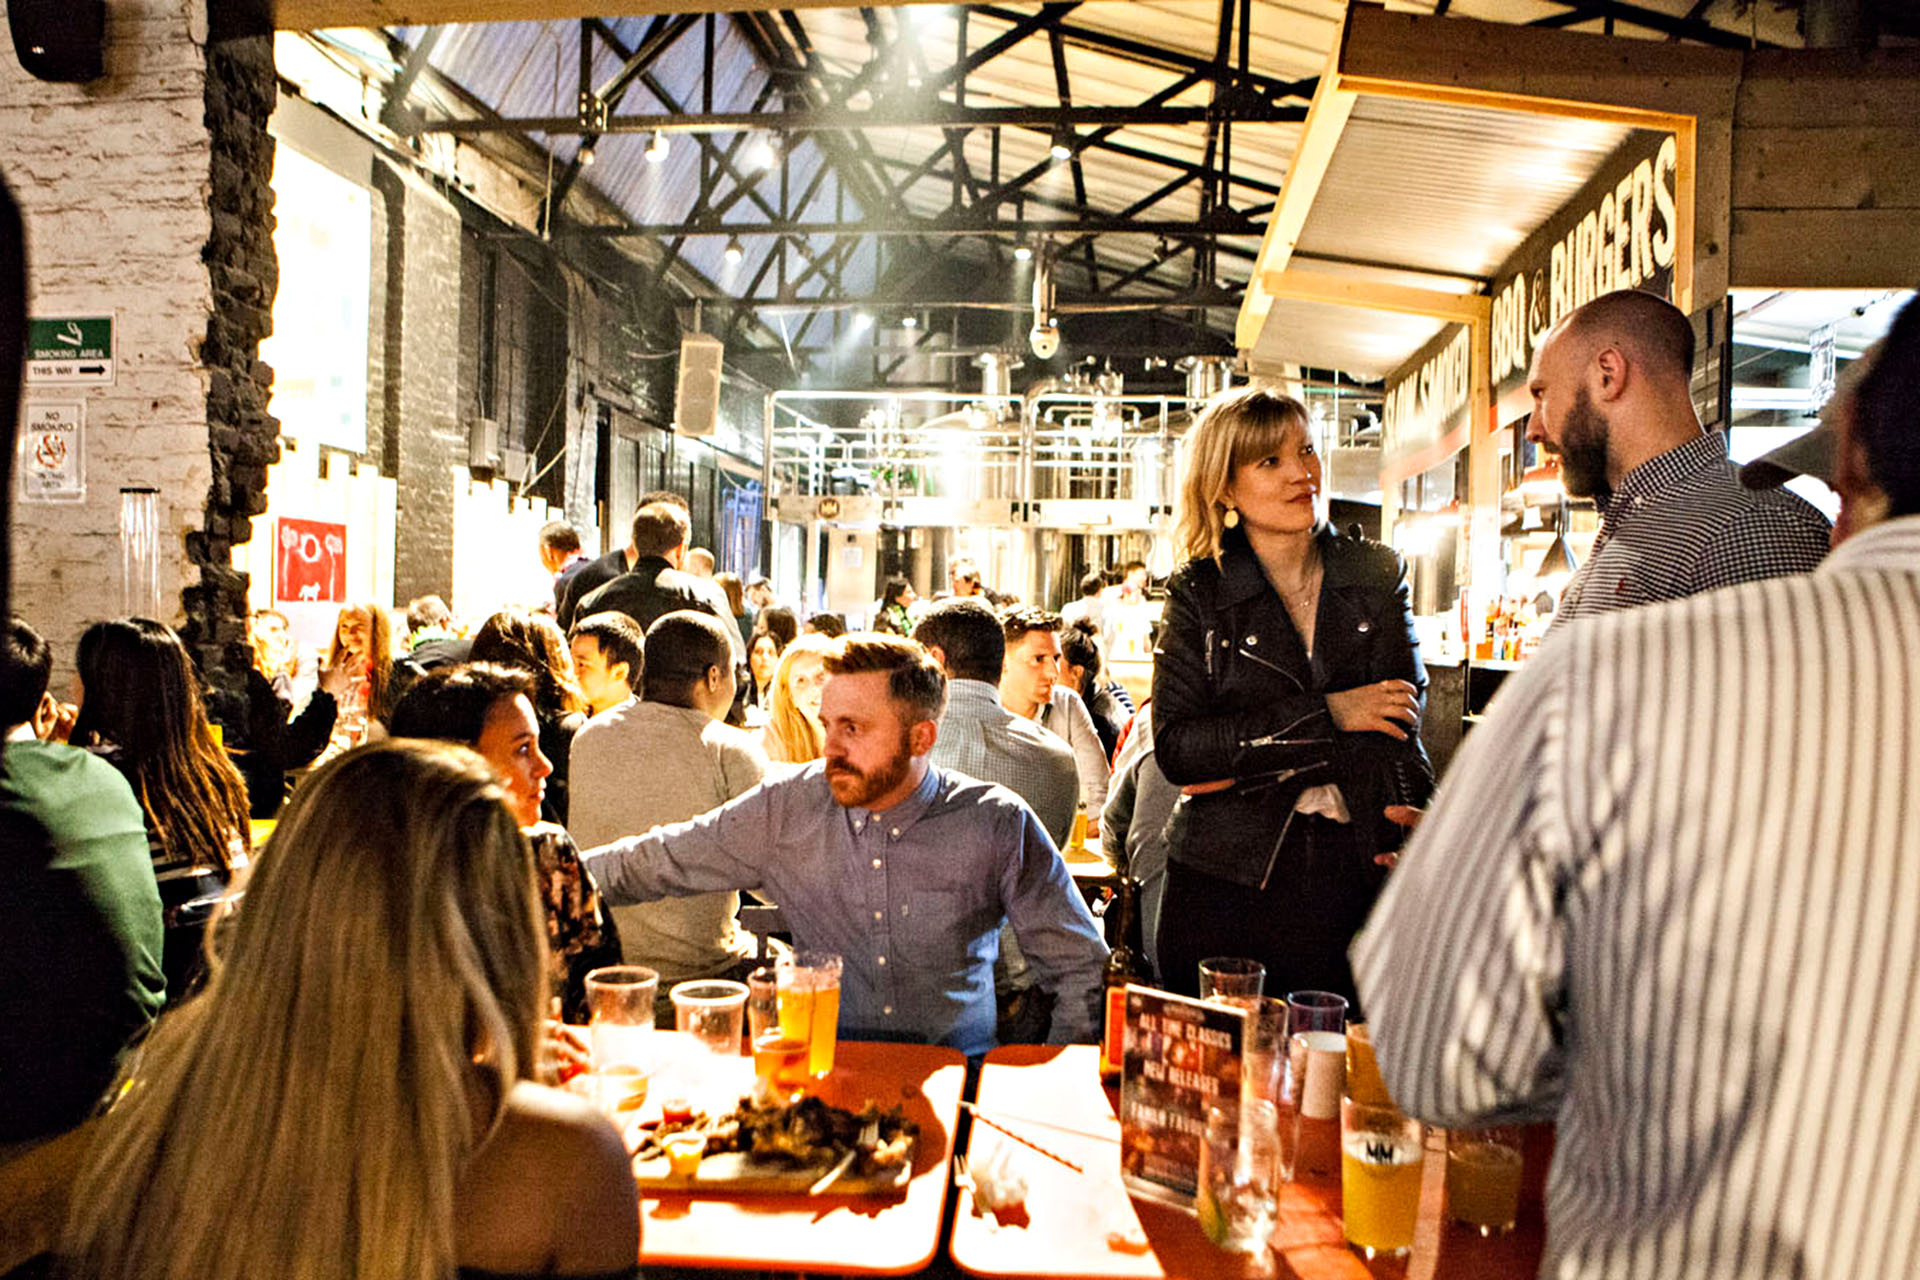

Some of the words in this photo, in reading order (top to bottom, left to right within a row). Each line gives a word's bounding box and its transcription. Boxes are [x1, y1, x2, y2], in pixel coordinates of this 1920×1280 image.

[1528, 268, 1548, 349] &
[1551, 135, 1676, 330] BURGERS
[33, 348, 77, 359] SMOKING
[79, 348, 105, 358] AREA
[32, 366, 53, 376] THIS
[55, 366, 73, 376] WAY
[45, 411, 60, 421] NO
[31, 422, 75, 433] SMOKING
